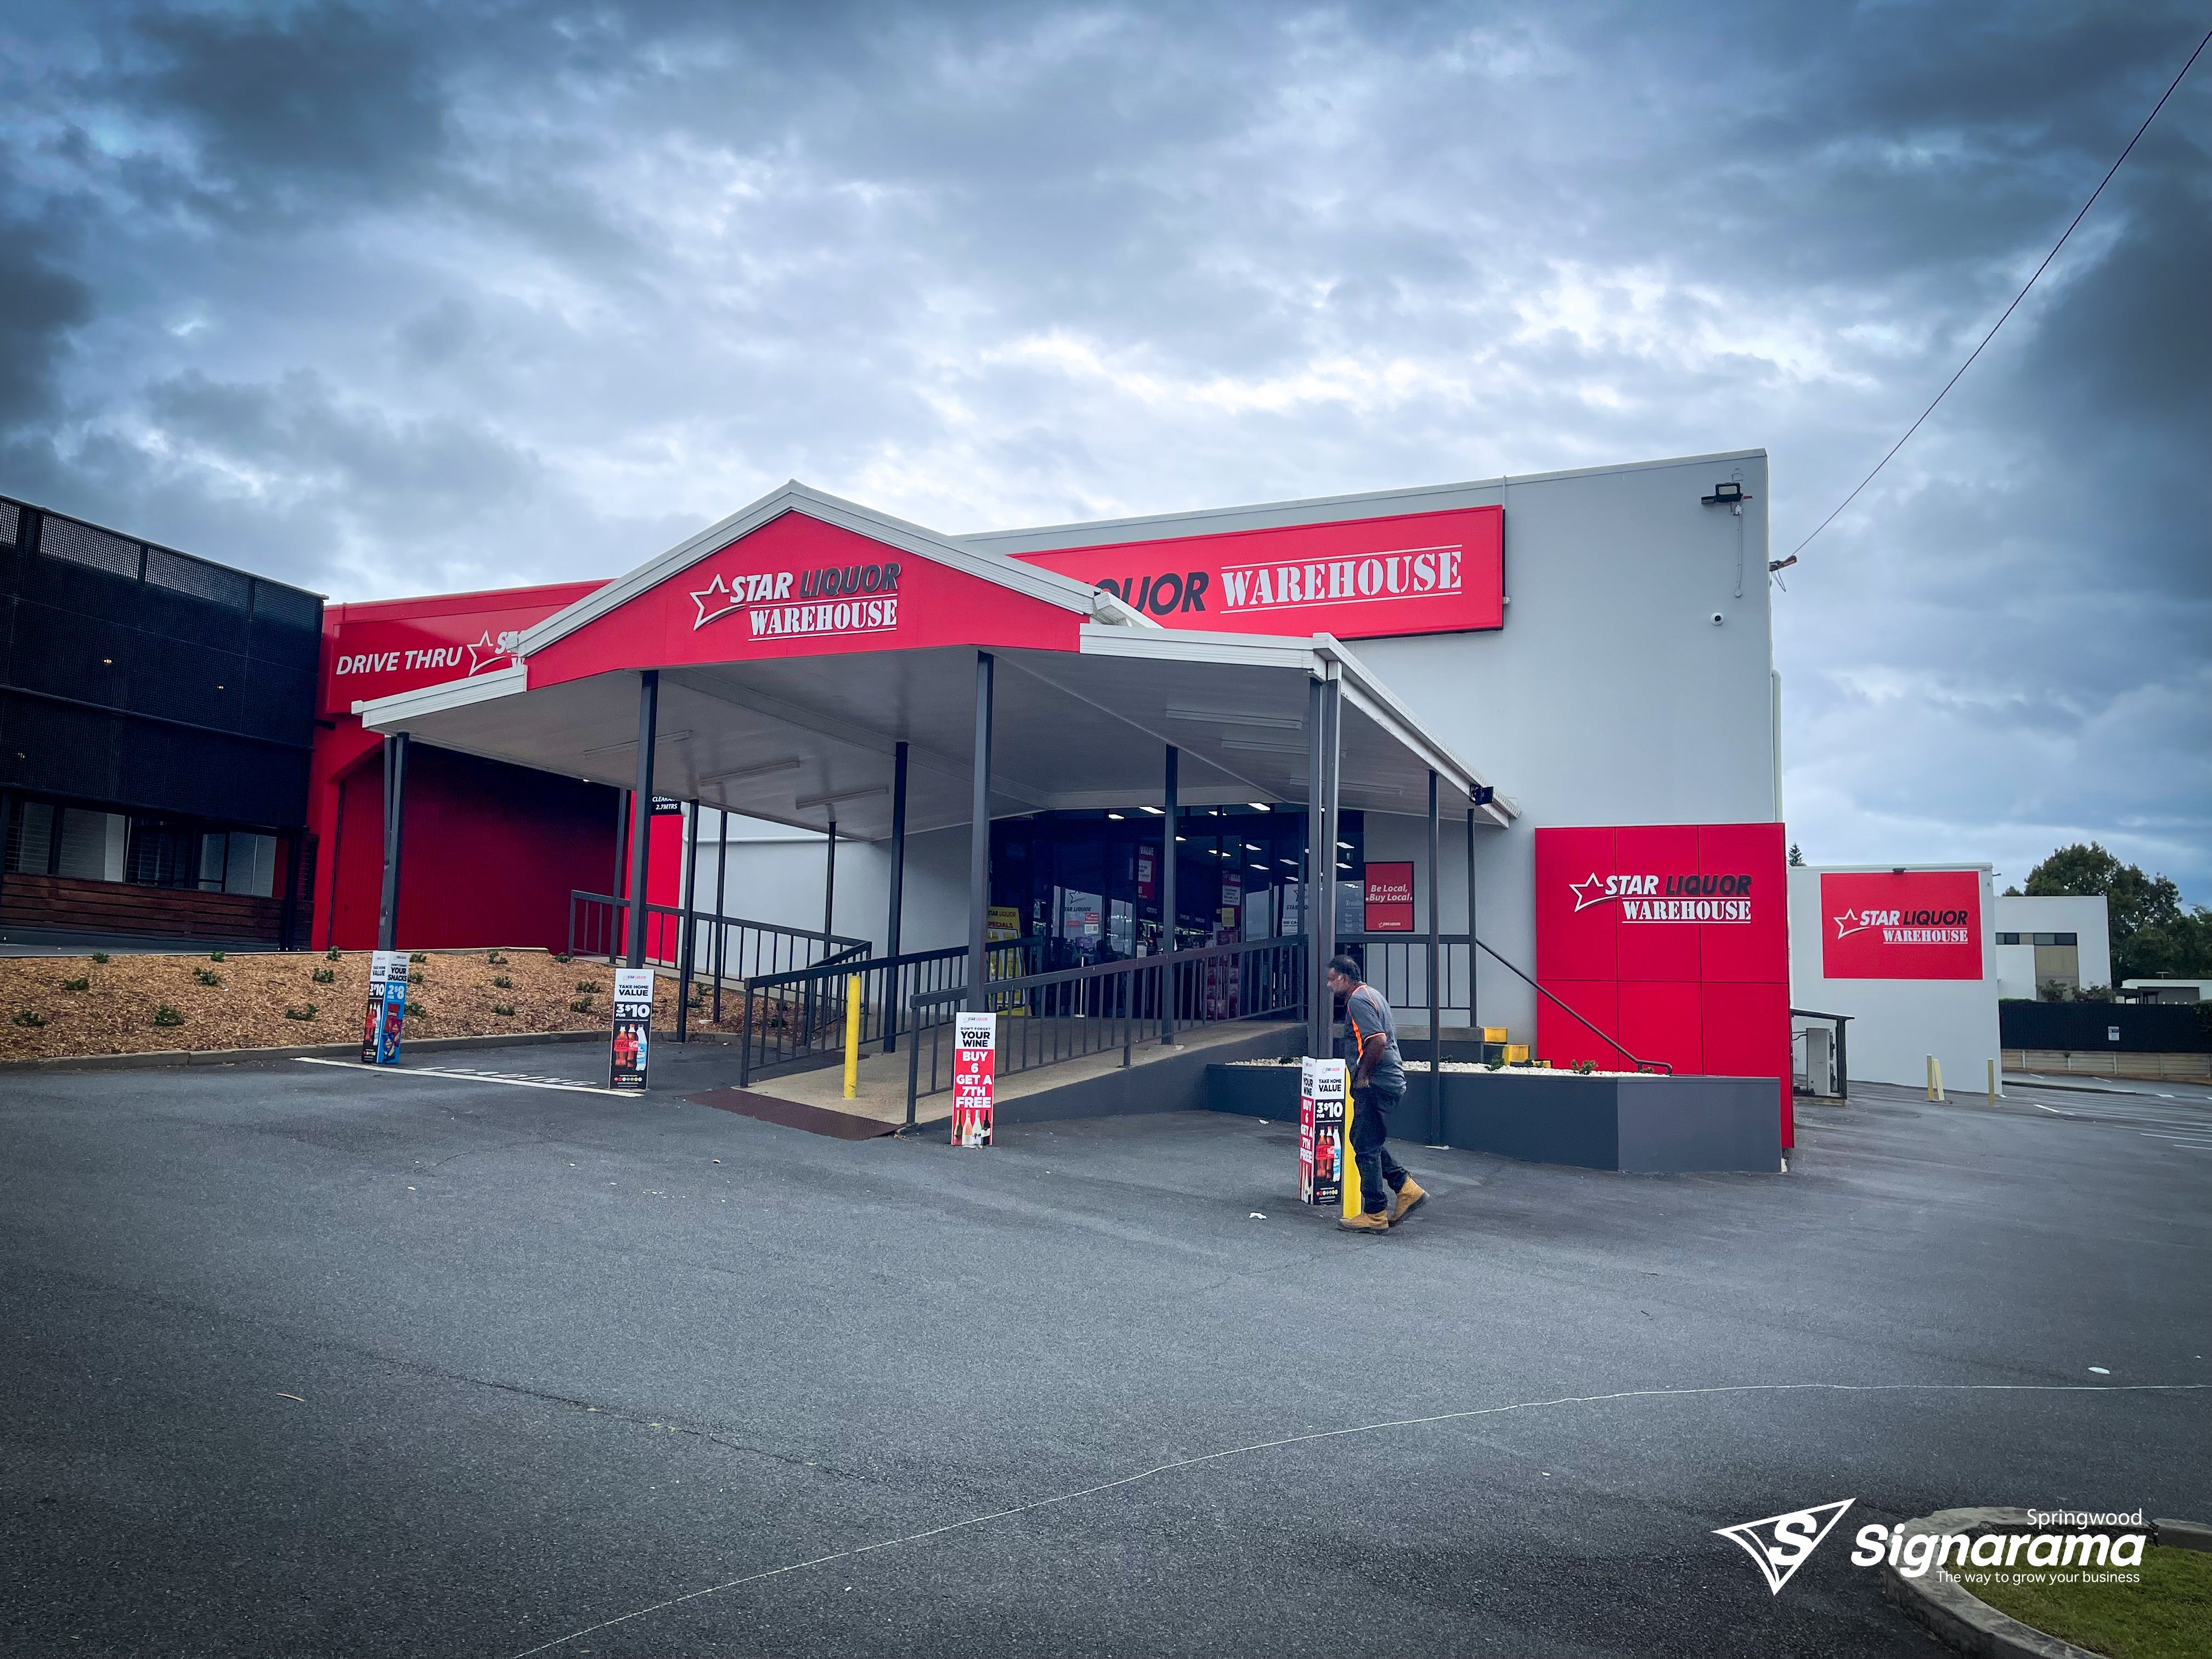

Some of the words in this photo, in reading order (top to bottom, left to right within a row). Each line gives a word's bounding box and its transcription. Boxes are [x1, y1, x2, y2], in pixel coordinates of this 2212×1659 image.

[730, 572, 793, 603] STAR
[799, 563, 901, 598] LIQUOR
[1221, 551, 1462, 607] WAREHOUSE
[749, 599, 897, 636] WAREHOUSE
[336, 652, 400, 675] DRIVE
[405, 646, 462, 670] THRU
[1383, 884, 1408, 893] Local,
[1605, 875, 1659, 895] STAR
[1666, 875, 1752, 895] LIQUOR
[1369, 893, 1386, 902] Buy
[1622, 901, 1751, 920] WAREHOUSE
[1860, 910, 1900, 926] STAR
[1903, 910, 1968, 926] LIQUOR
[1883, 930, 1968, 942] WAREHOUSE
[388, 985, 394, 995] 2
[616, 1004, 624, 1013] 3
[625, 1005, 650, 1018] $10
[962, 1051, 988, 1062] BUY
[970, 1063, 979, 1073] 6
[956, 1074, 981, 1085] GET
[983, 1074, 992, 1085] A
[1304, 1077, 1313, 1087] YOUR
[962, 1086, 986, 1096] 7TH
[956, 1096, 991, 1108] FREE
[1303, 1099, 1312, 1111] BUY
[1317, 1102, 1323, 1113] 3
[1324, 1102, 1343, 1118] $10
[1305, 1113, 1309, 1124] 6
[1301, 1124, 1309, 1136] GET
[1309, 1126, 1313, 1138] A
[1302, 1136, 1311, 1150] 7TH
[1300, 1147, 1312, 1164] FREE
